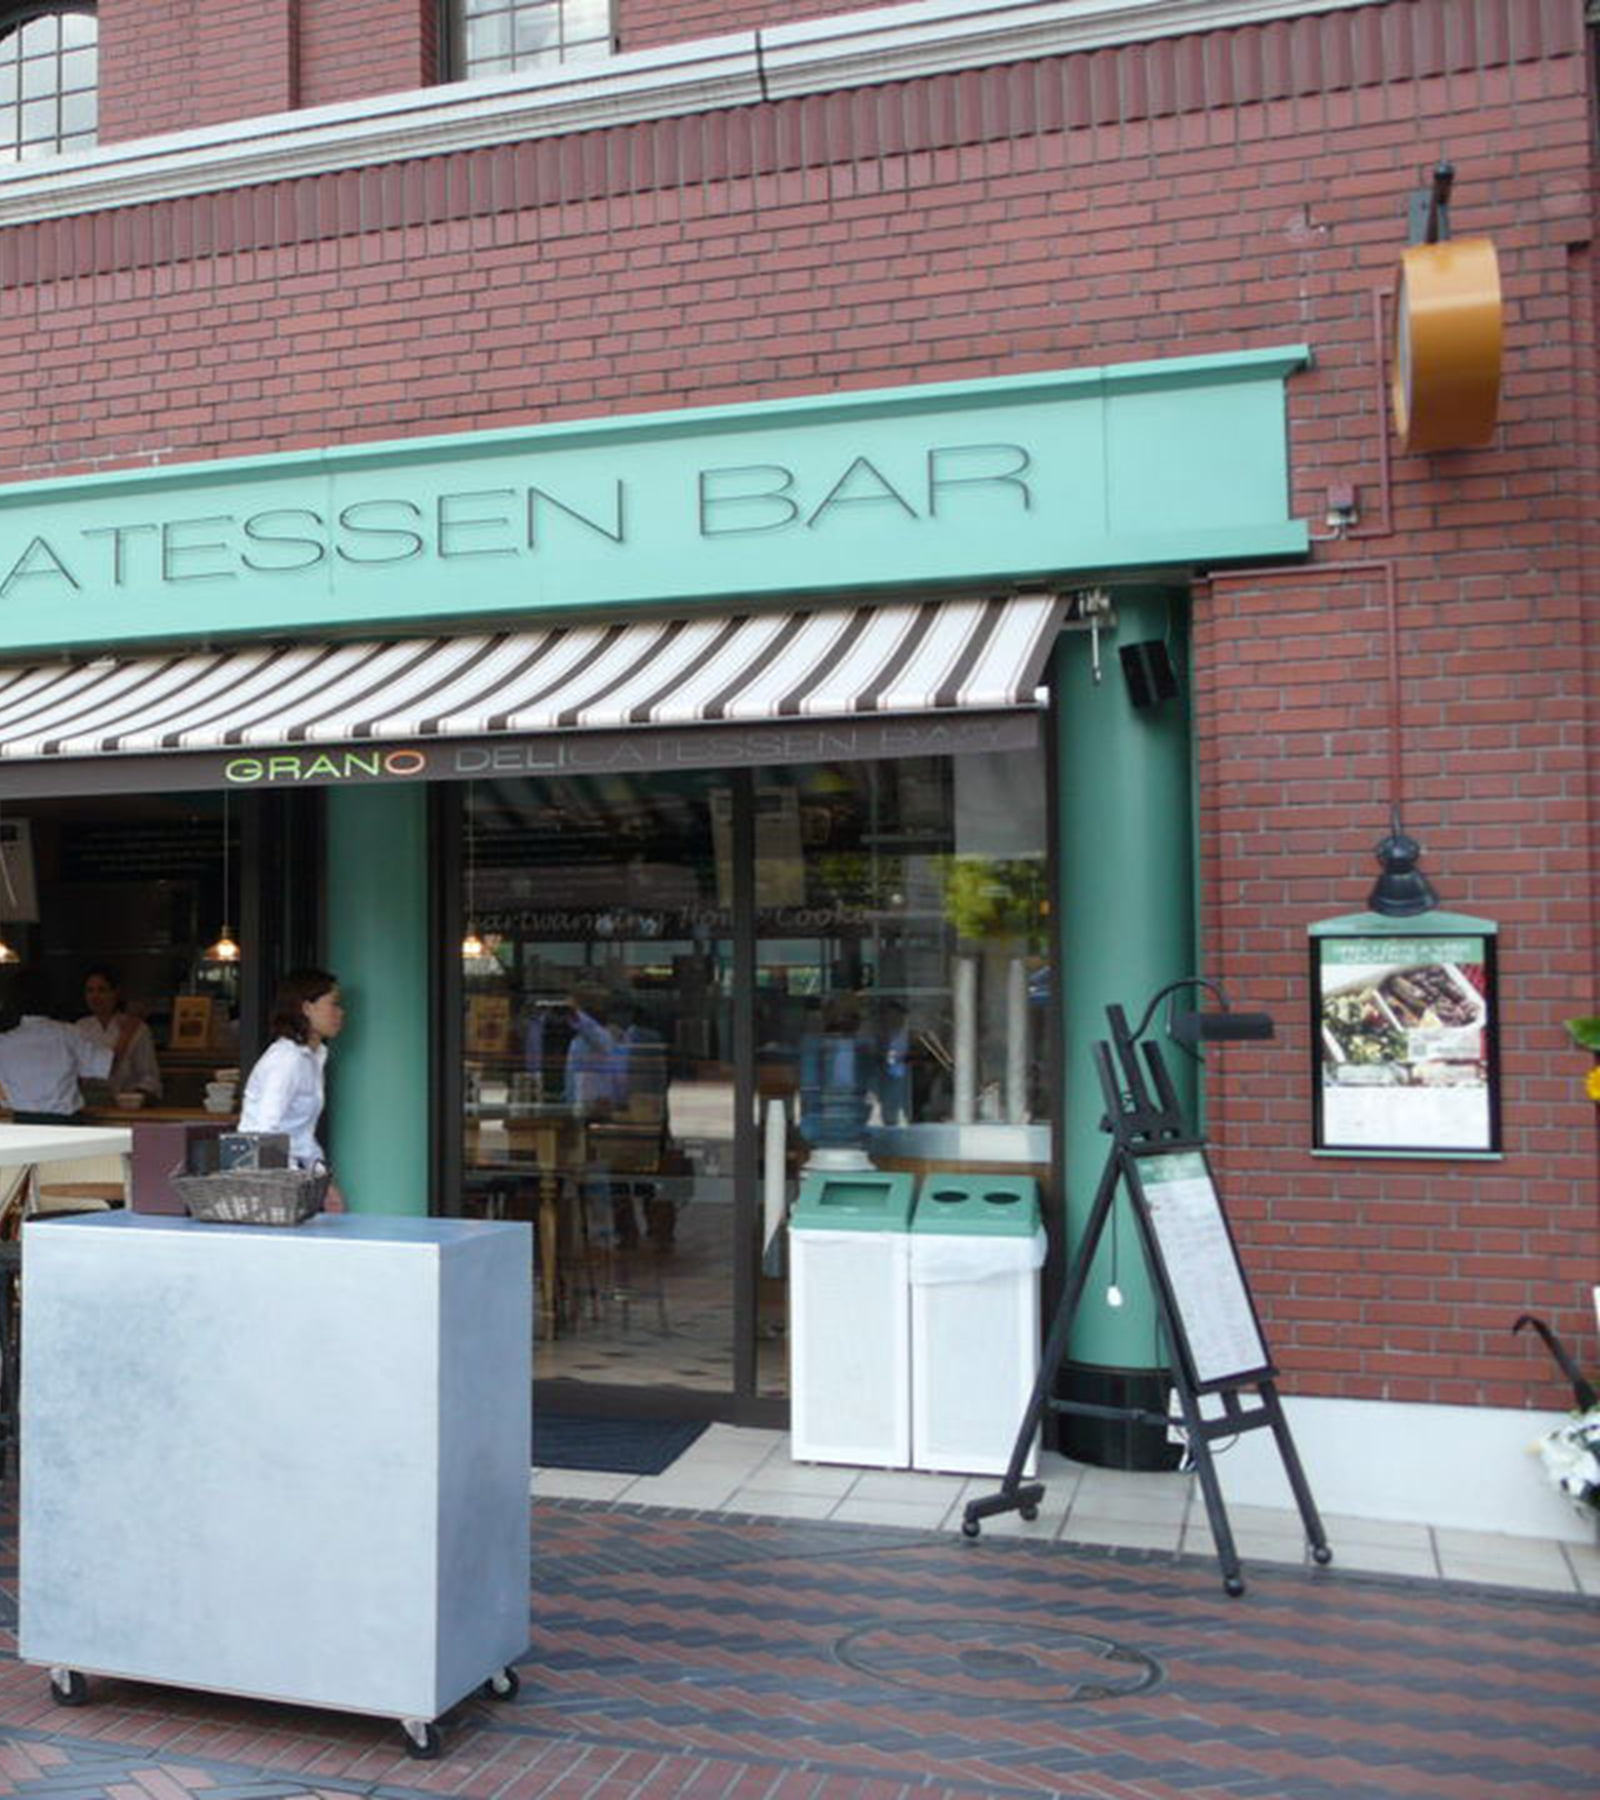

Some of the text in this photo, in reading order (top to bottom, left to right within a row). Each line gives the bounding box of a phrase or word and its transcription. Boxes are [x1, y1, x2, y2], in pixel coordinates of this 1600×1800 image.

[699, 444, 1032, 537] BAR
[225, 749, 427, 783] GRANO
[454, 732, 858, 774] DELICATESSEN
